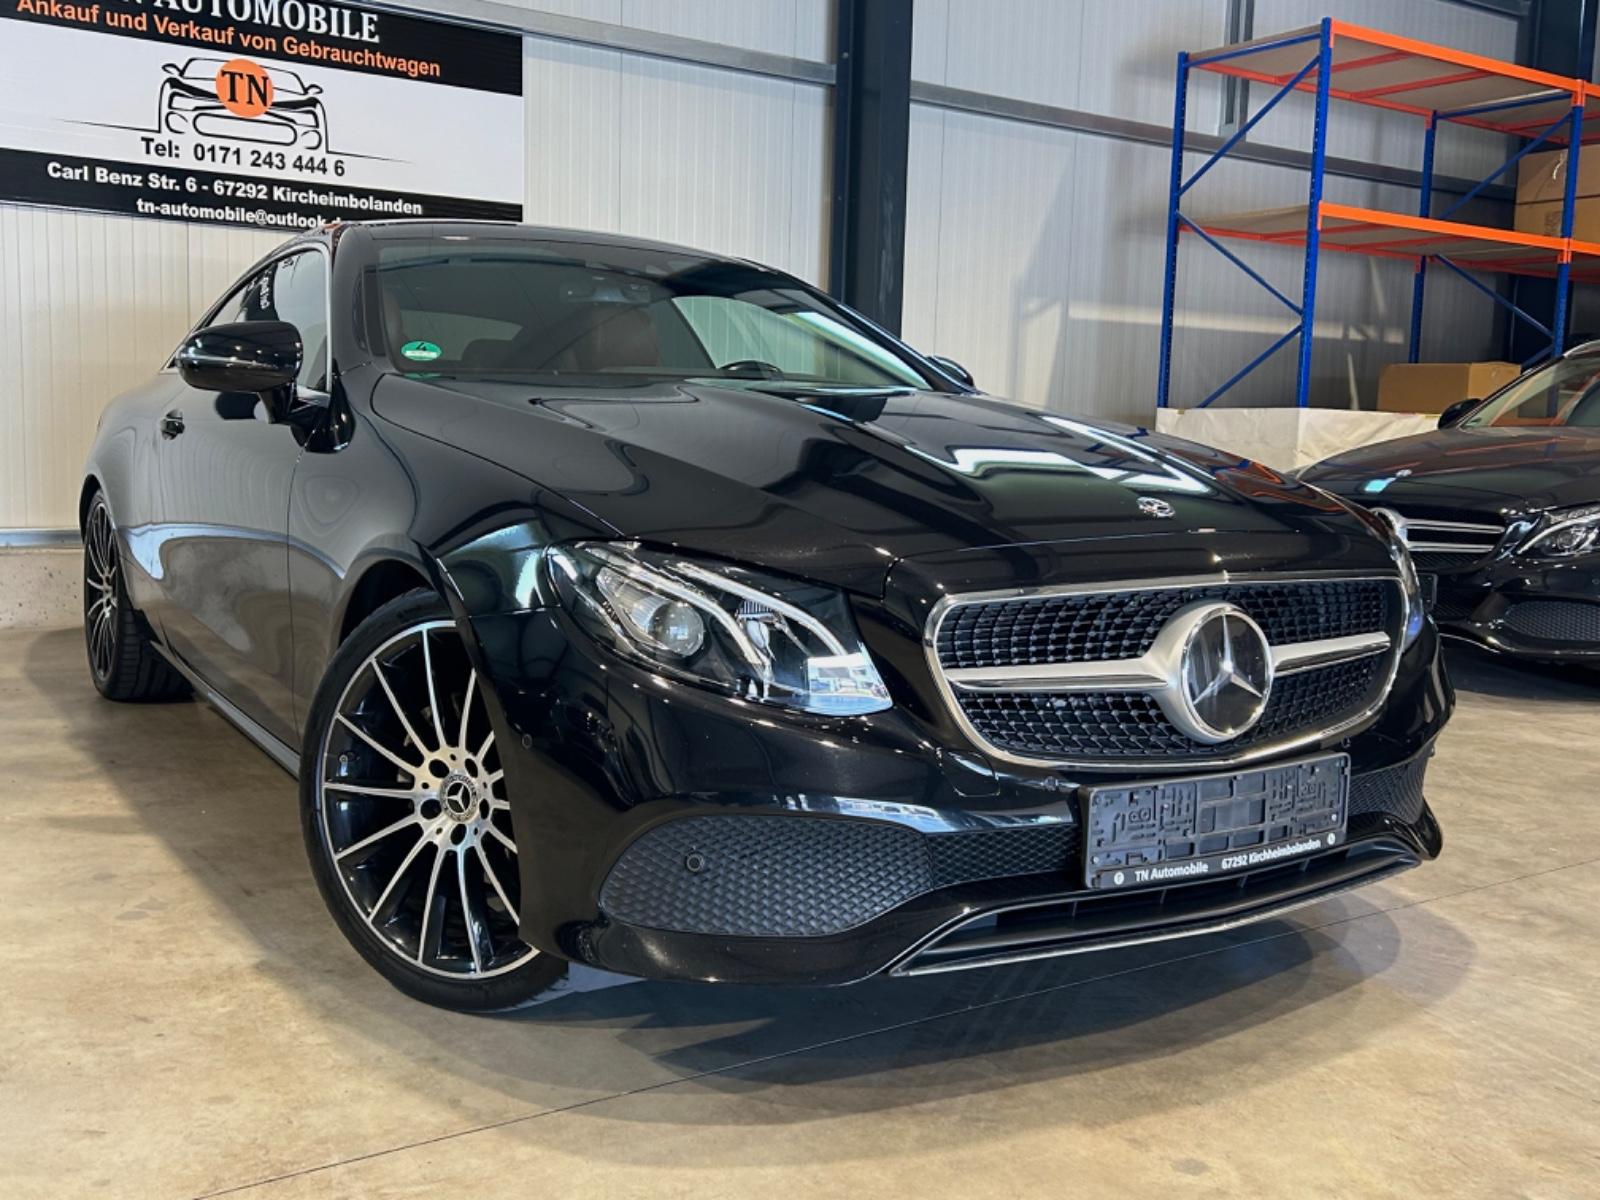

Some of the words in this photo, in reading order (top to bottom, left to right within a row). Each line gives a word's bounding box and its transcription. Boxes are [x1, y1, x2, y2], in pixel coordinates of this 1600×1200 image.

[17, 0, 99, 23] Ankauf
[106, 11, 147, 31] und
[153, 14, 235, 45] Verkauf
[240, 33, 277, 52] von
[283, 36, 441, 77] Gebrauchtwagen
[221, 70, 269, 107] TN
[141, 137, 180, 158] Tel:
[194, 143, 241, 165] 0171
[250, 150, 285, 170] 243
[293, 156, 327, 174] 444
[334, 160, 345, 176] 6
[47, 162, 89, 181] Carl
[95, 167, 143, 187] Benz
[148, 173, 180, 191] Str.
[185, 177, 197, 192] 6
[213, 180, 268, 199] 67292
[273, 186, 422, 215] Kircheimbolanden
[136, 198, 341, 228] tn-automobile@outlook
[1135, 869, 1149, 882] TN
[1150, 861, 1209, 880] Automobile
[1221, 855, 1248, 870] 67292
